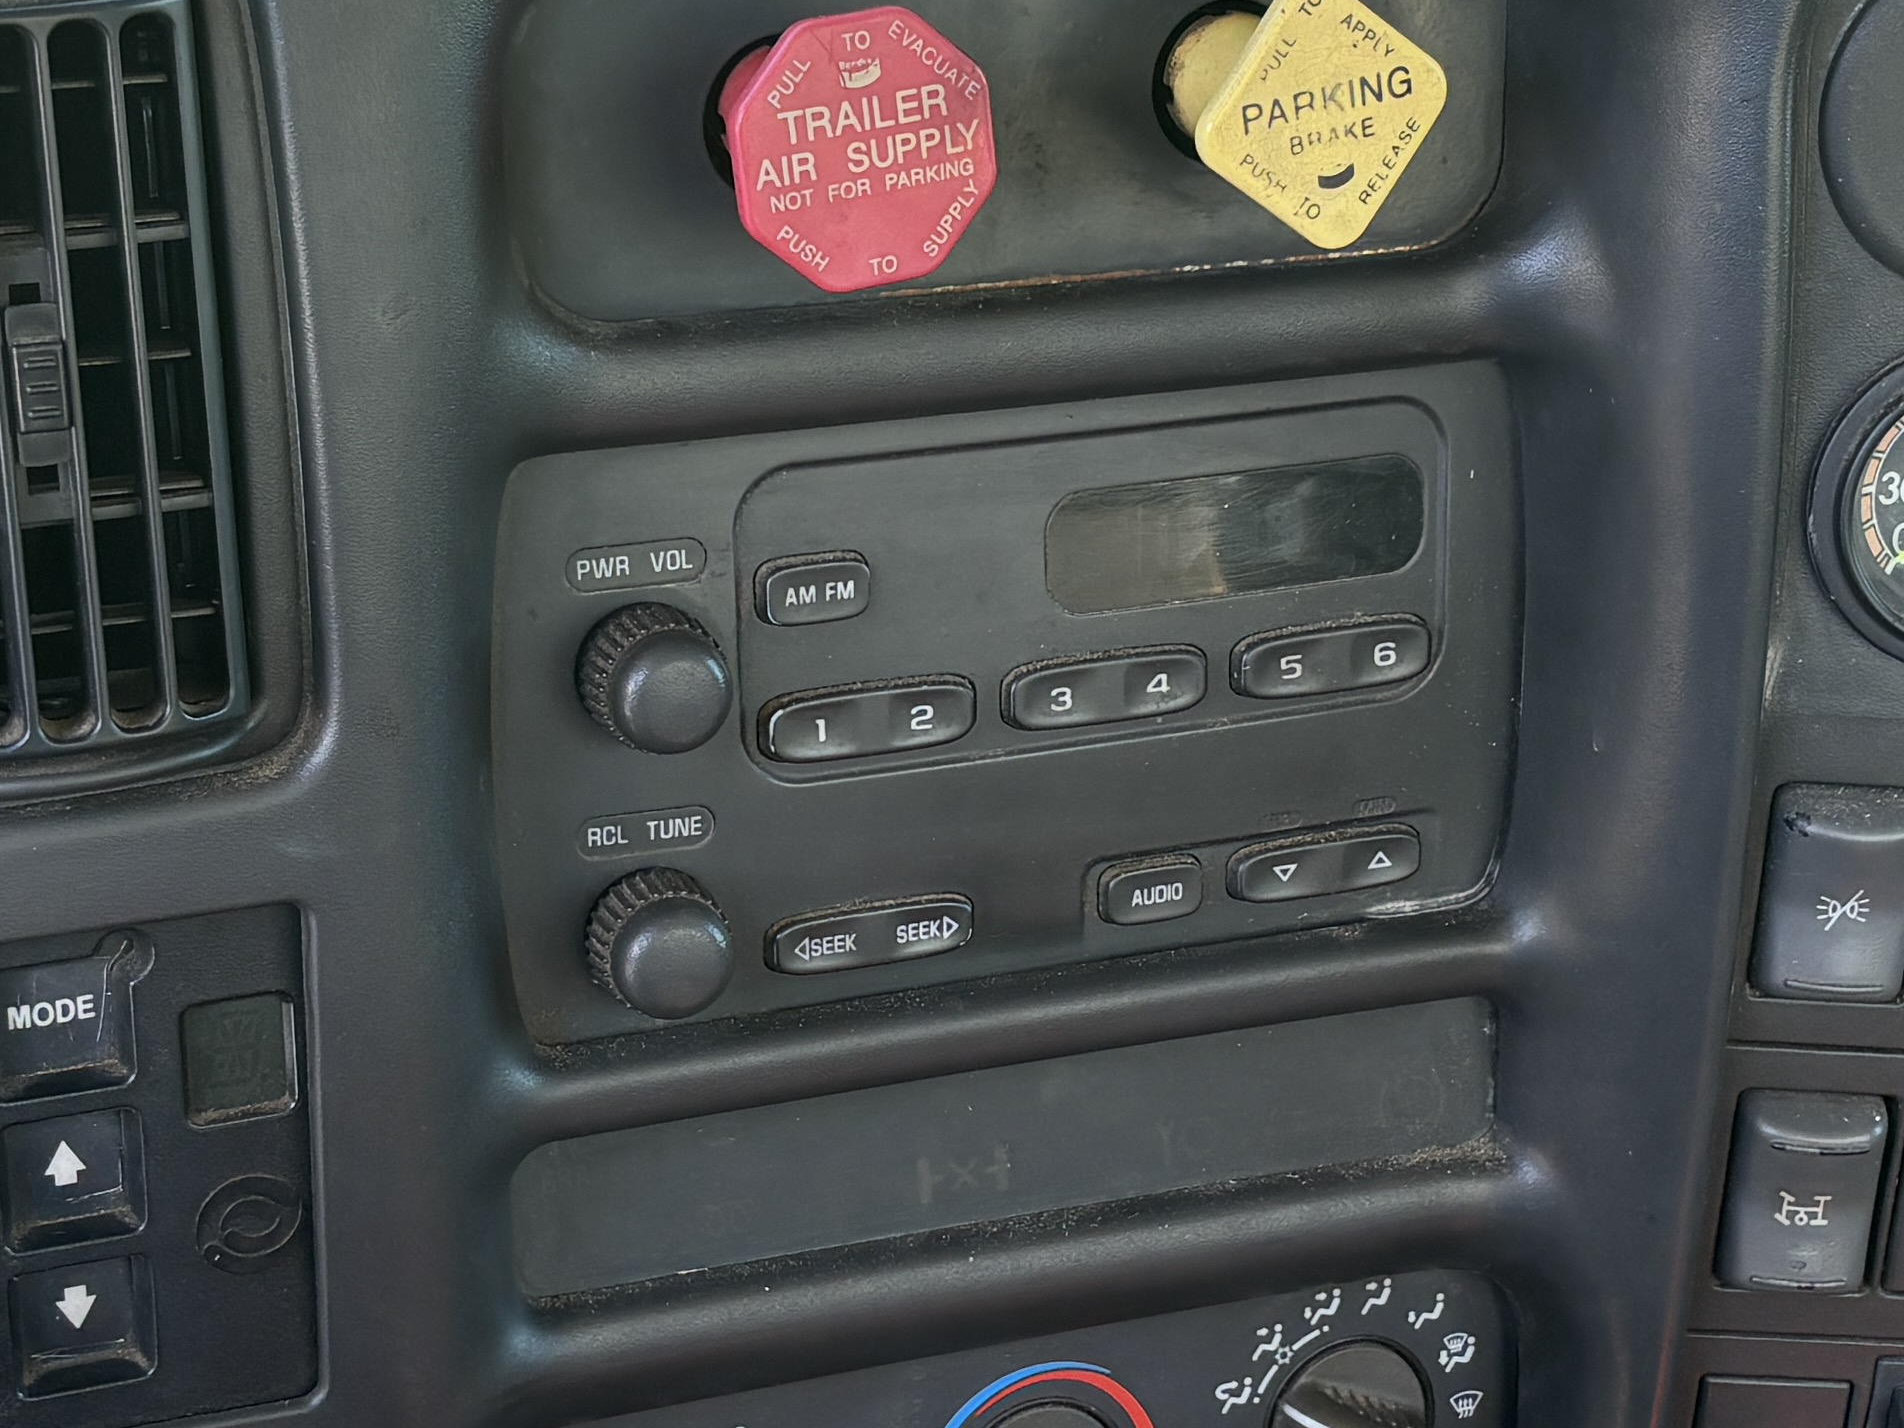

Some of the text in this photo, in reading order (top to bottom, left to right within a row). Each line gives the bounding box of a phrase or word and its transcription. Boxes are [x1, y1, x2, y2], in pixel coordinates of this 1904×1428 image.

[1340, 13, 1395, 57] APPLY
[767, 20, 981, 109] PULL TO EVACUATE
[777, 84, 948, 145] TRAILER
[1241, 65, 1413, 136] PARKING
[756, 119, 979, 191] AIR SUPPLY
[1290, 116, 1376, 155] BRAKE
[770, 158, 974, 213] NOT FOR PARKING
[1239, 116, 1421, 220] PUSH TO RELEASE
[777, 179, 978, 276] PUSH TO SUPPLY
[576, 549, 693, 580] PWR VOL
[785, 580, 855, 608] AM FM
[1279, 641, 1396, 680] 5 6
[1050, 672, 1171, 712] 3 4
[815, 704, 935, 743] 1 2
[587, 815, 703, 848] RCL TUNE
[1131, 882, 1183, 907] AUDIO
[810, 918, 942, 958] SEEK SEEK
[6, 993, 97, 1031] MODE
